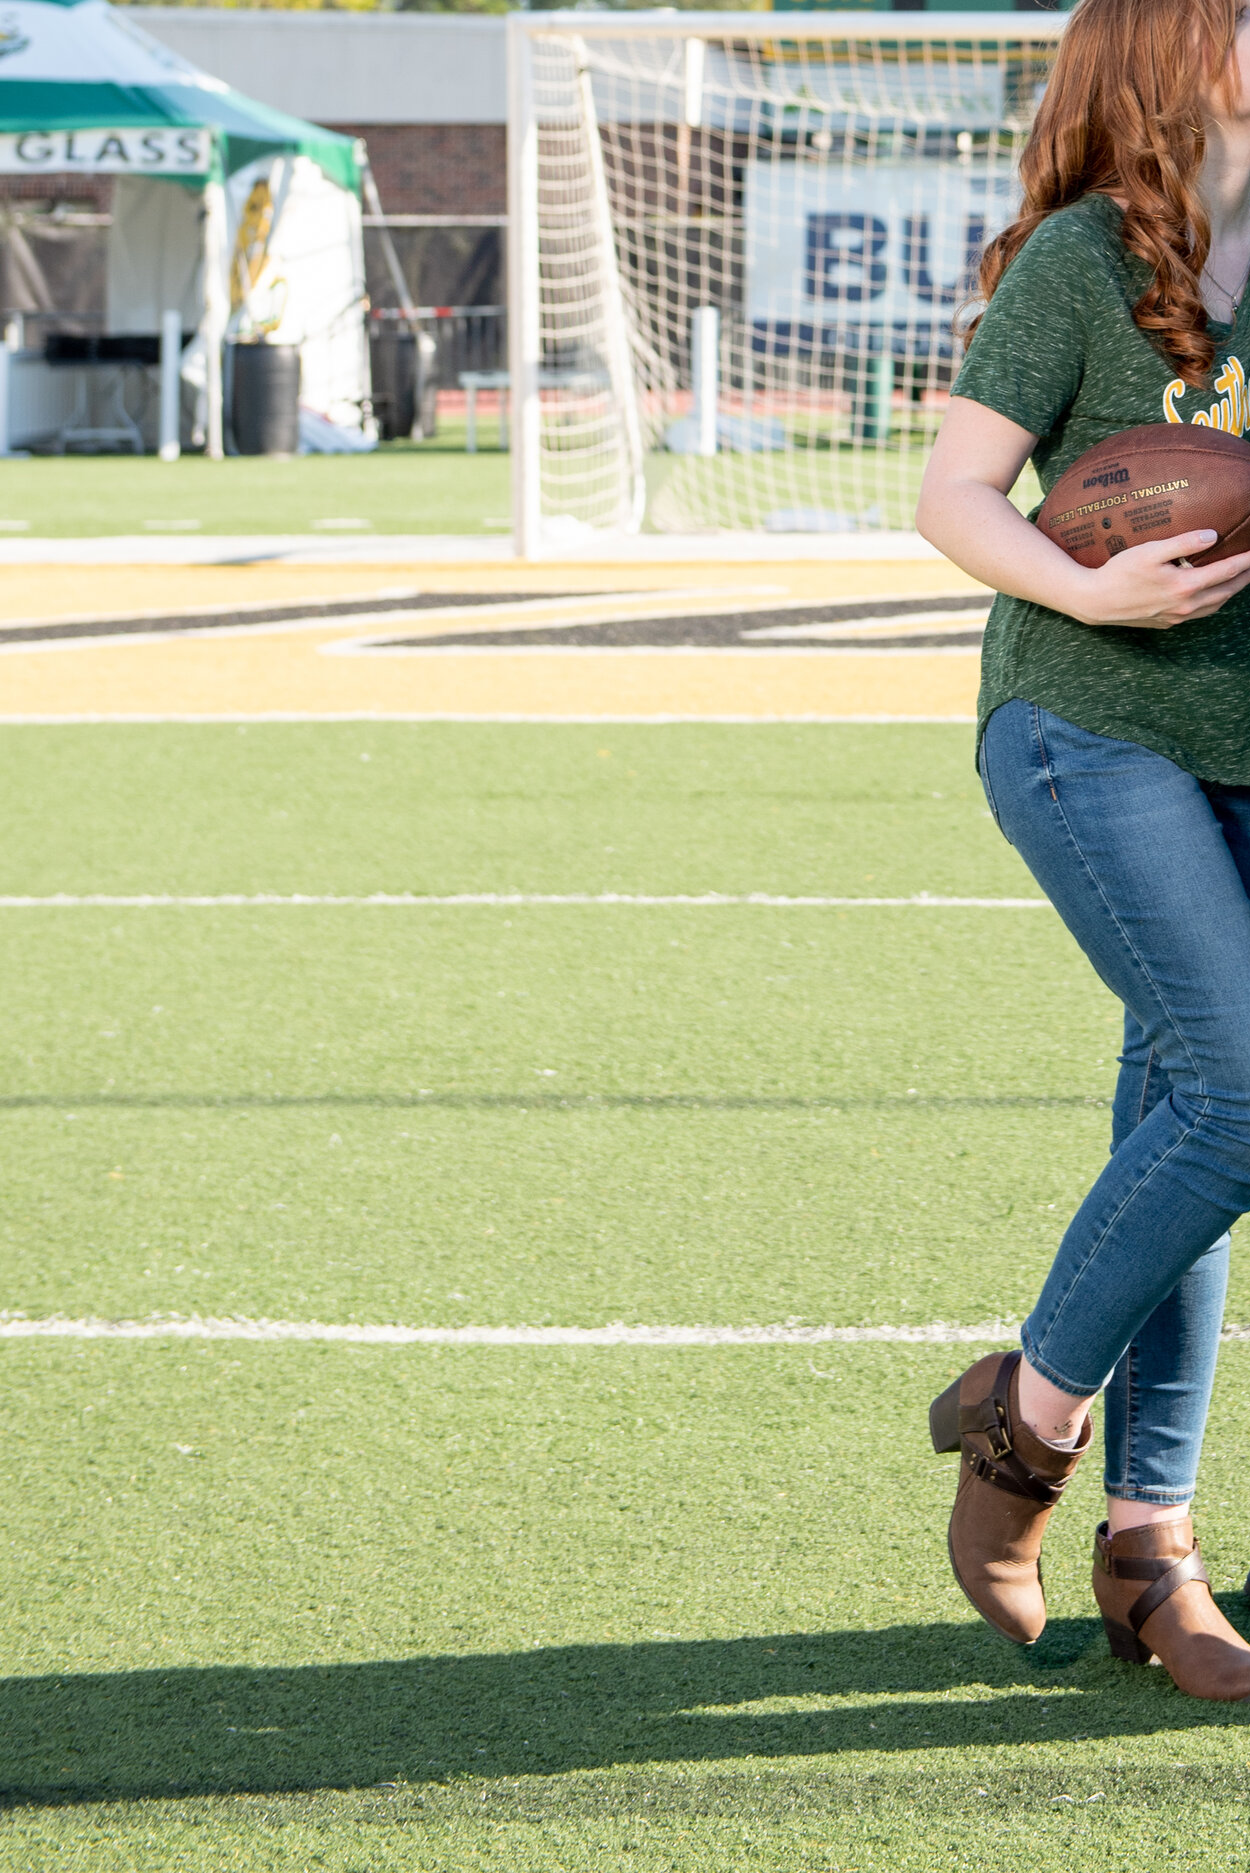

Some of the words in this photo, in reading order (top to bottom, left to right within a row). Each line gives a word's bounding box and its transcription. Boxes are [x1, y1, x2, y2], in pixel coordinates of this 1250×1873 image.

[14, 131, 201, 164] GLASS
[1083, 468, 1130, 488] Wilson
[1131, 478, 1190, 500] NATIONAL
[1077, 493, 1128, 516] FOOTBALL
[1048, 510, 1075, 528] LEAGUE
